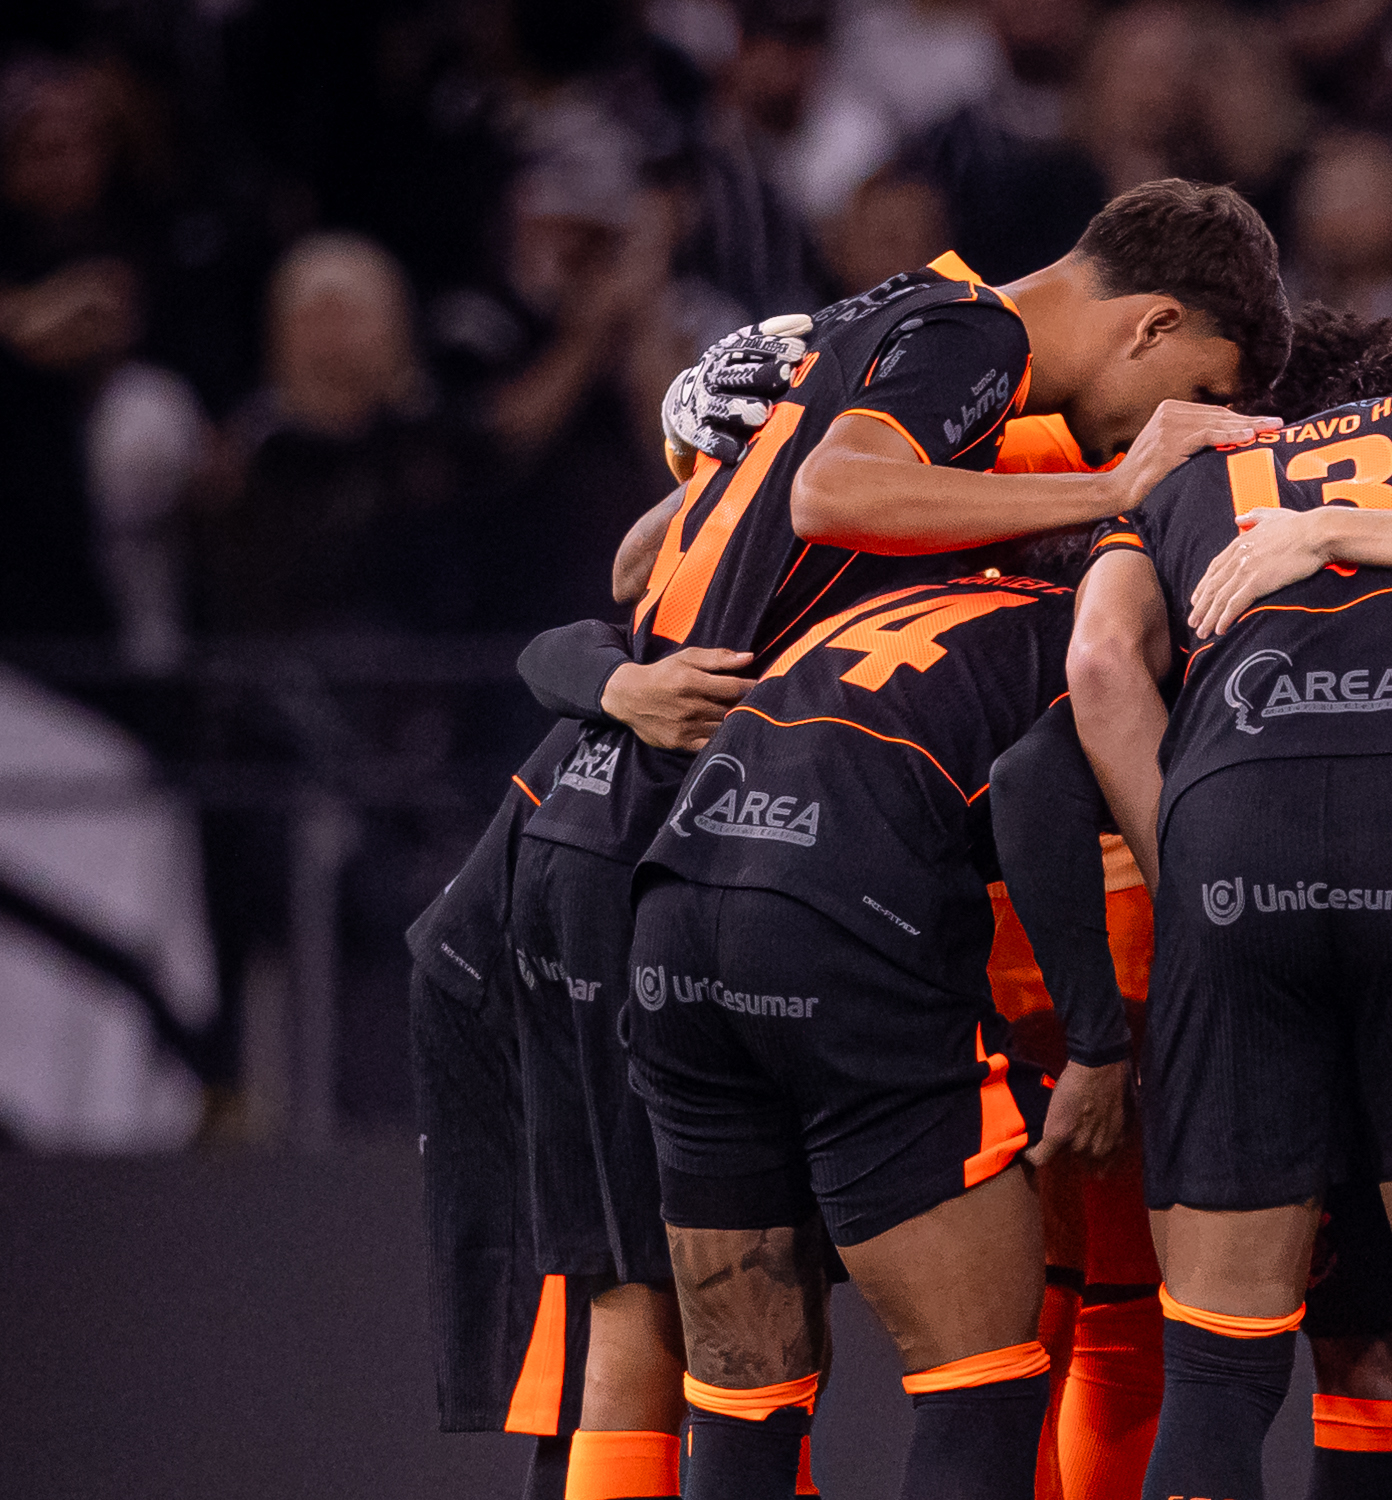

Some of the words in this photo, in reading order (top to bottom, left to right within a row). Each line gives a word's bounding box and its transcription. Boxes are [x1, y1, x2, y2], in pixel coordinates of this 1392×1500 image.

[1216, 414, 1361, 452] STAVO
[758, 584, 1040, 692] 14
[702, 789, 820, 835] AREA
